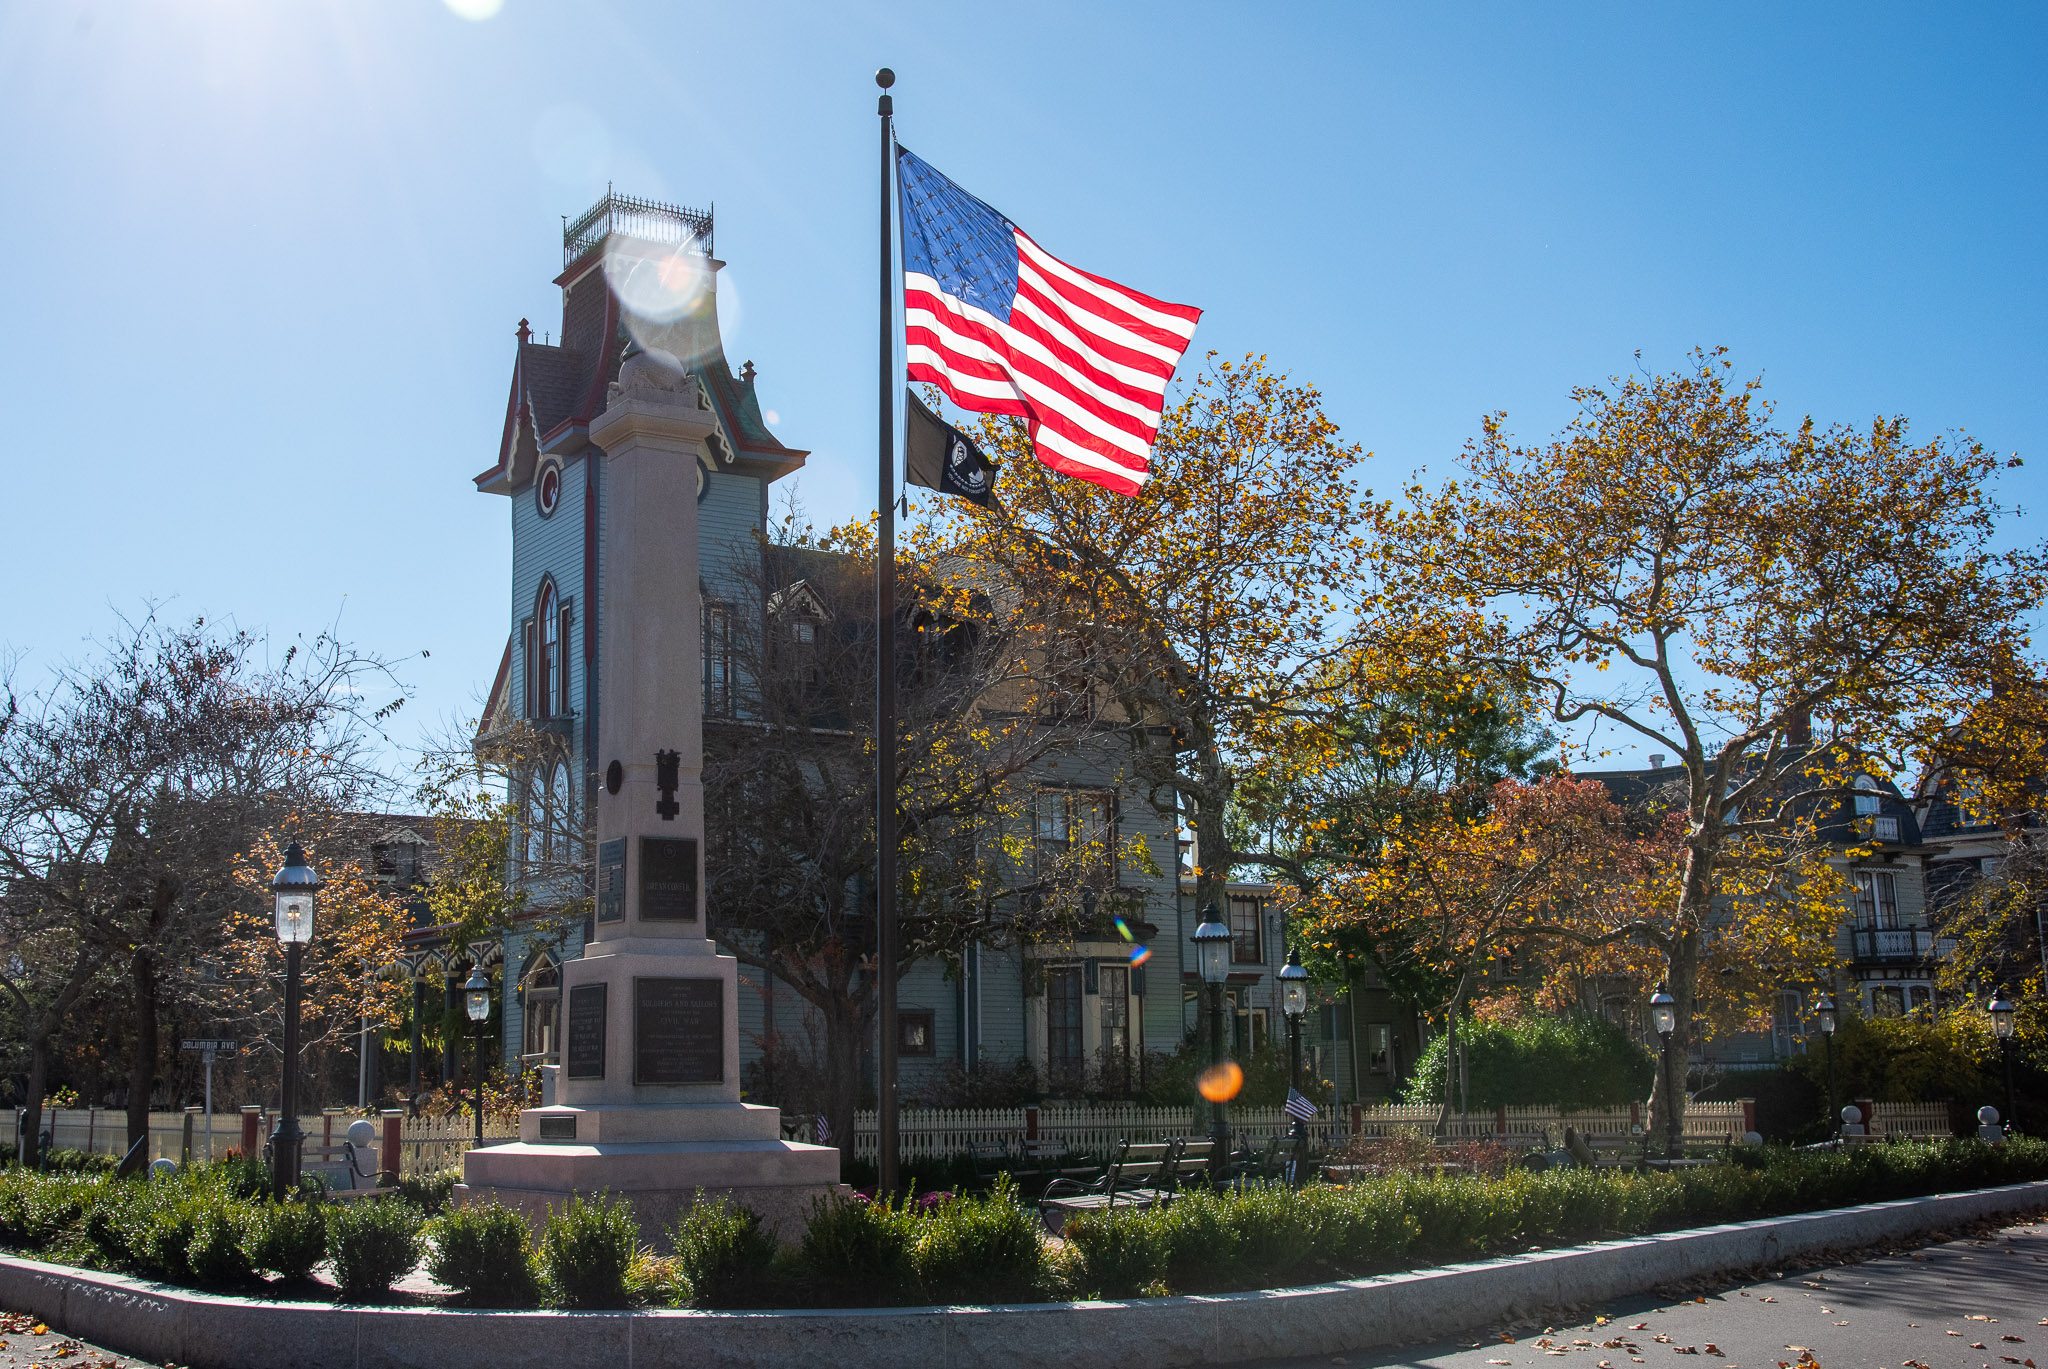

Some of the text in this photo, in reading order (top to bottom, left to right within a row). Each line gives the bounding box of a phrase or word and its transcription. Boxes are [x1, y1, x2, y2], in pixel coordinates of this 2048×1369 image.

[947, 472, 955, 481] YOU
[674, 1000, 689, 1008] AND
[182, 1041, 235, 1050] COLUMBIA AVE
